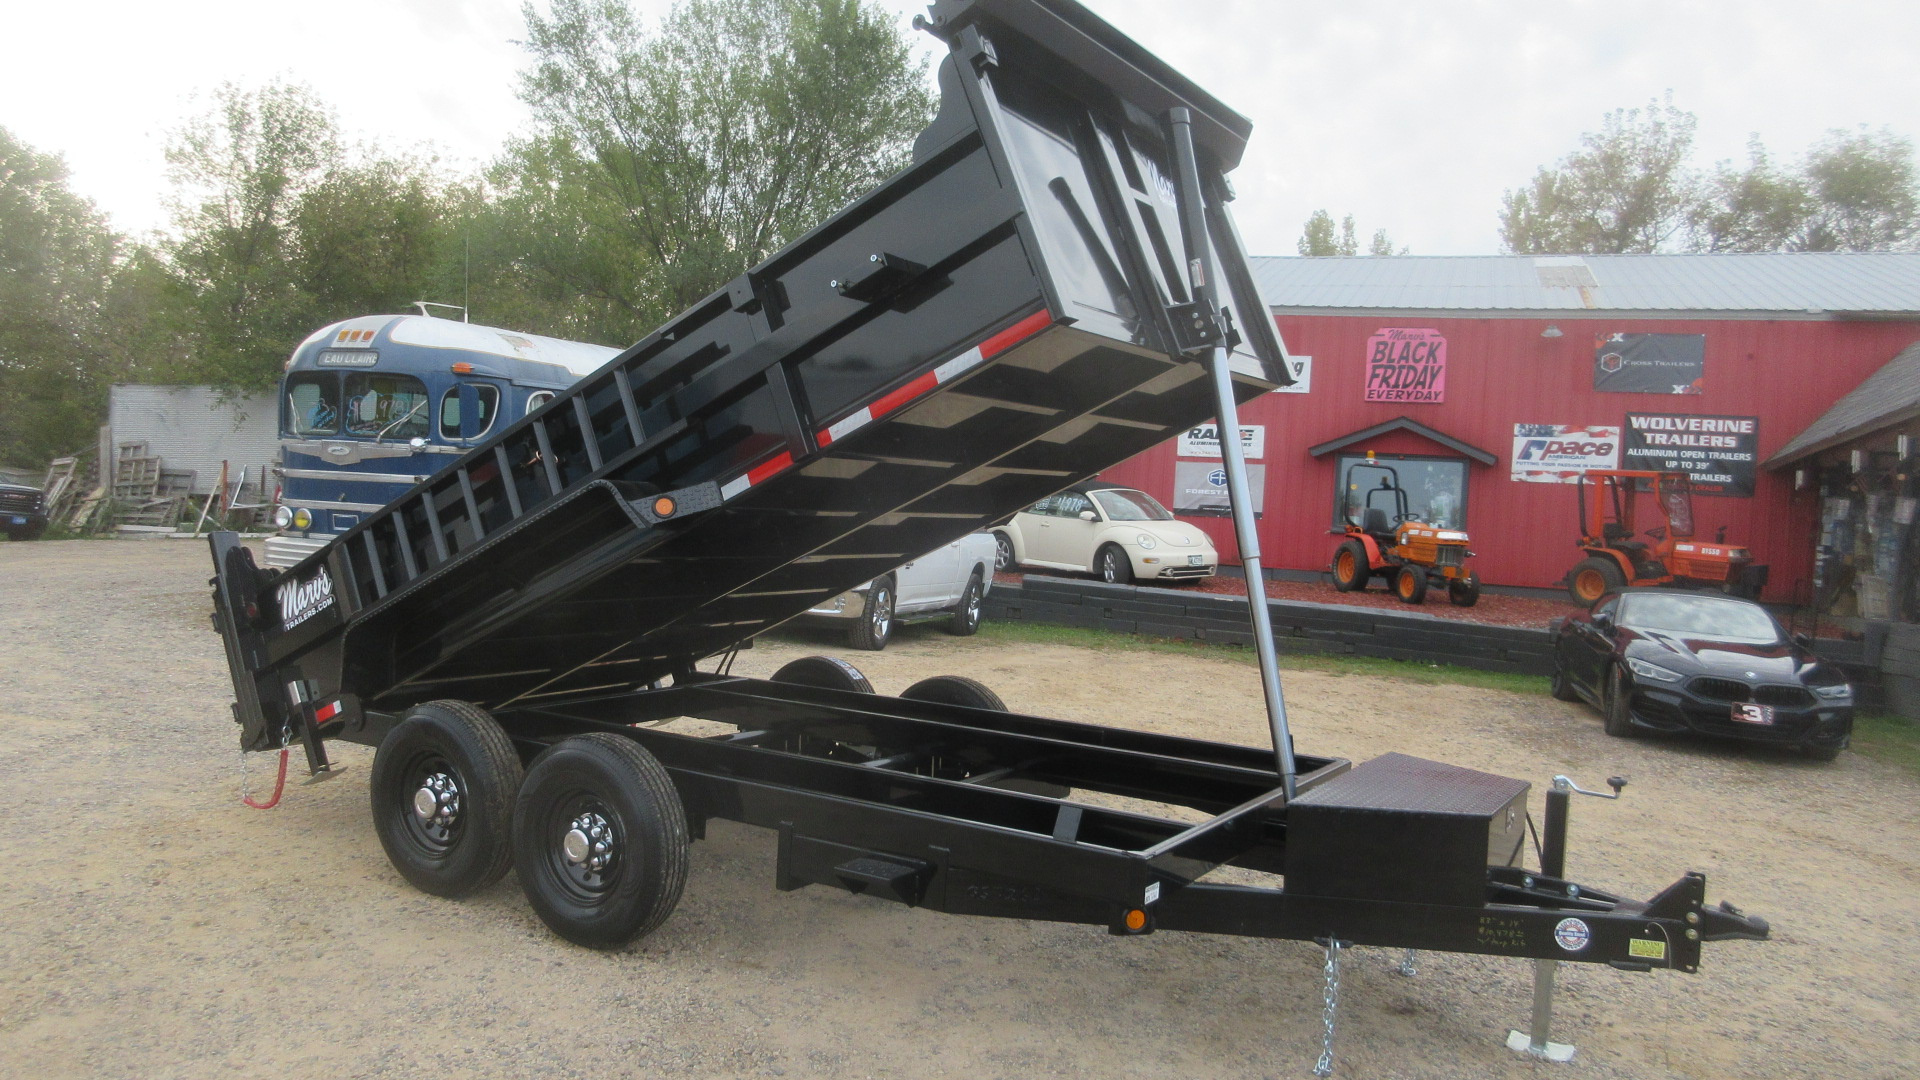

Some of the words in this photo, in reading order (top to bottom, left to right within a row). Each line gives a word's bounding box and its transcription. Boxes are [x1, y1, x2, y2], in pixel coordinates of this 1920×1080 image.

[1371, 341, 1443, 364] BLACK
[1367, 364, 1443, 390] FRIDAY
[1367, 389, 1443, 401] EVERYDAY
[1630, 416, 1753, 433] WOLVERINE
[1643, 432, 1737, 448] TRAILERS
[1539, 440, 1614, 460] pace
[1627, 448, 1678, 458] ALUMINUM
[1680, 450, 1705, 459] OPEN
[1708, 451, 1752, 461] TRAILERS
[1680, 461, 1693, 469] TO
[1689, 472, 1732, 483] TRAILERS
[278, 566, 332, 620] Marv's
[285, 596, 334, 631] TRAILERS.COM
[1742, 705, 1762, 721] 3
